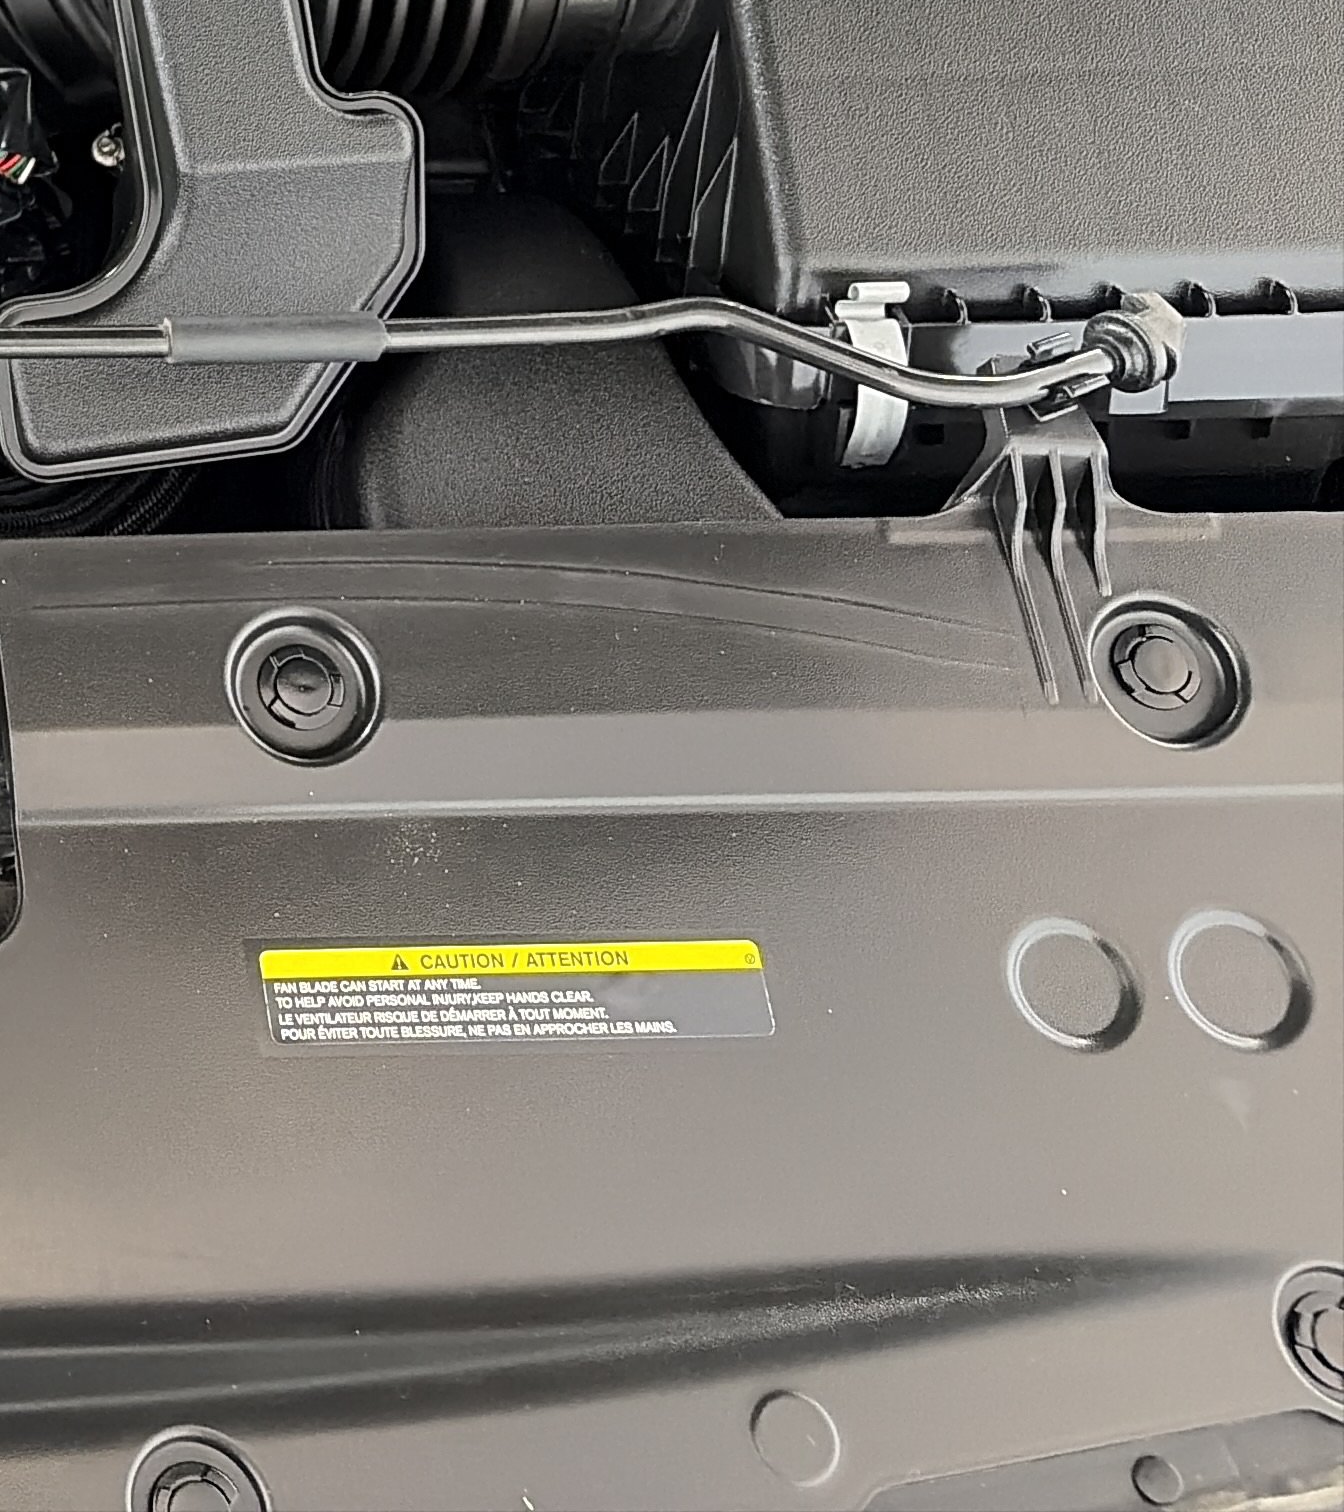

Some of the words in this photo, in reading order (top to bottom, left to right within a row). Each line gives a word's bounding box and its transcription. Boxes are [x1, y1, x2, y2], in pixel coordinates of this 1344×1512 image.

[420, 952, 505, 970] CAUTION
[511, 952, 519, 969] /
[526, 950, 630, 968] ATTENTION
[273, 981, 298, 994] FAN
[300, 980, 339, 994] BLADE
[339, 979, 367, 993] CAN
[368, 978, 405, 992] START
[407, 979, 423, 991] AT
[423, 978, 449, 991] ANY
[450, 977, 482, 990] TIME.
[275, 996, 293, 1009] TO
[295, 995, 326, 1008] HELP
[327, 994, 365, 1008] AVOID
[366, 992, 431, 1007] PERSONAL
[506, 991, 549, 1004] HANDS
[550, 990, 595, 1004] CLEAR.
[278, 1013, 293, 1026] LE
[294, 1011, 372, 1025] VENTILATEUR
[373, 1010, 420, 1024] RISQUE
[421, 1010, 439, 1023] DE
[440, 1006, 508, 1022] DÉMARRER
[508, 1005, 519, 1021] À
[518, 1007, 552, 1021] TOUT
[553, 1006, 610, 1020] MOMENT.
[280, 1027, 316, 1041] POUR
[318, 1024, 359, 1040] ÉVITER
[359, 1025, 399, 1039] TOUTE
[400, 1024, 467, 1039] BLESSURE,
[469, 1023, 486, 1037] NE
[487, 1023, 512, 1036] PAS
[514, 1022, 531, 1036] EN
[532, 1021, 610, 1035] APPROCHER
[609, 1021, 634, 1034] LES
[634, 1019, 678, 1034] MAINS.
